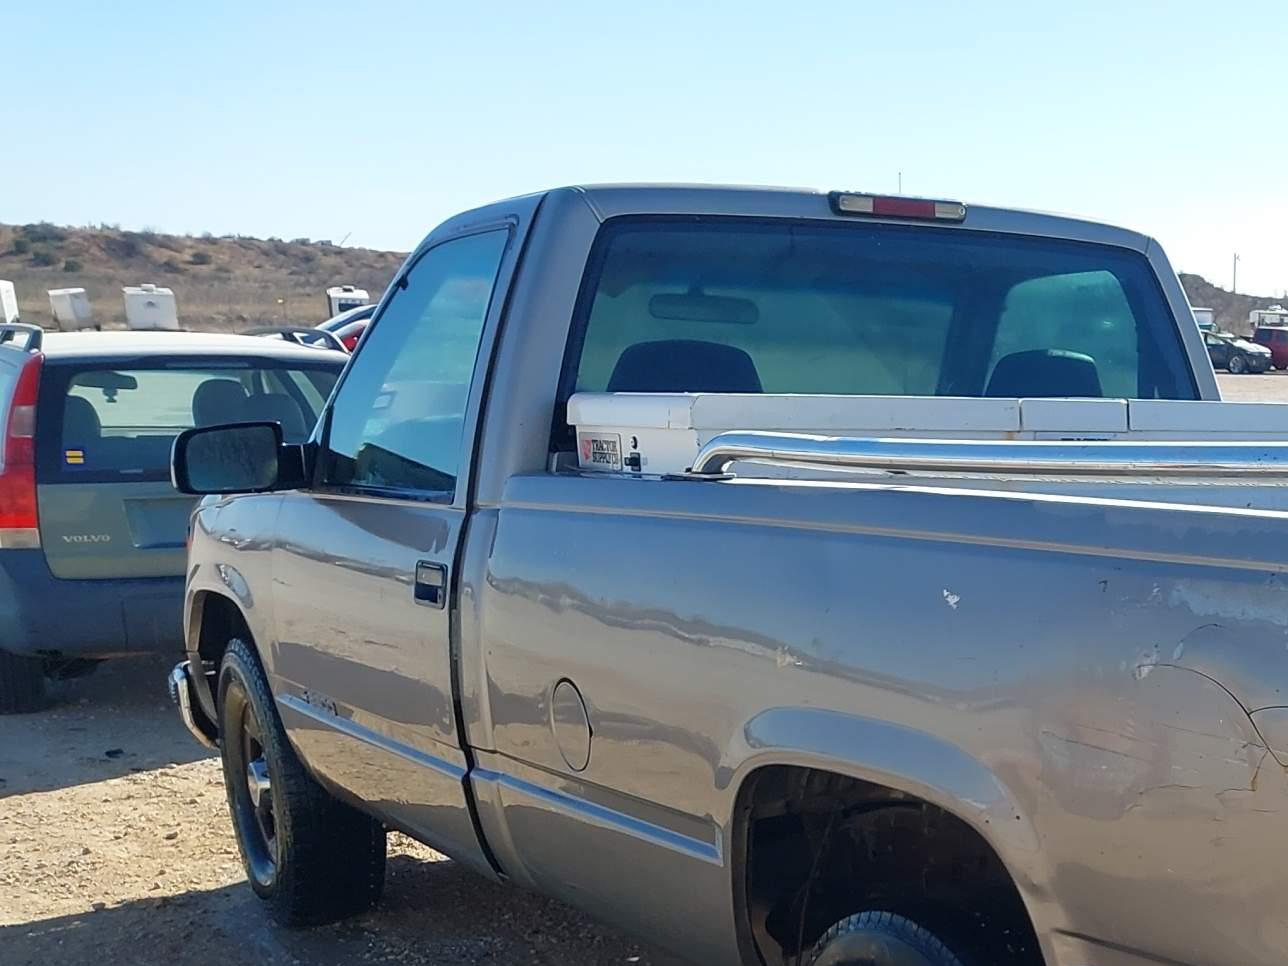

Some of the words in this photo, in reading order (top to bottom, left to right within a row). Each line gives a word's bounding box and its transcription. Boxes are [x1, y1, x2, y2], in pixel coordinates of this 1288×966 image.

[592, 439, 618, 452] TRACTOR
[592, 452, 612, 464] SUPPLY
[62, 534, 111, 543] VOLVO
